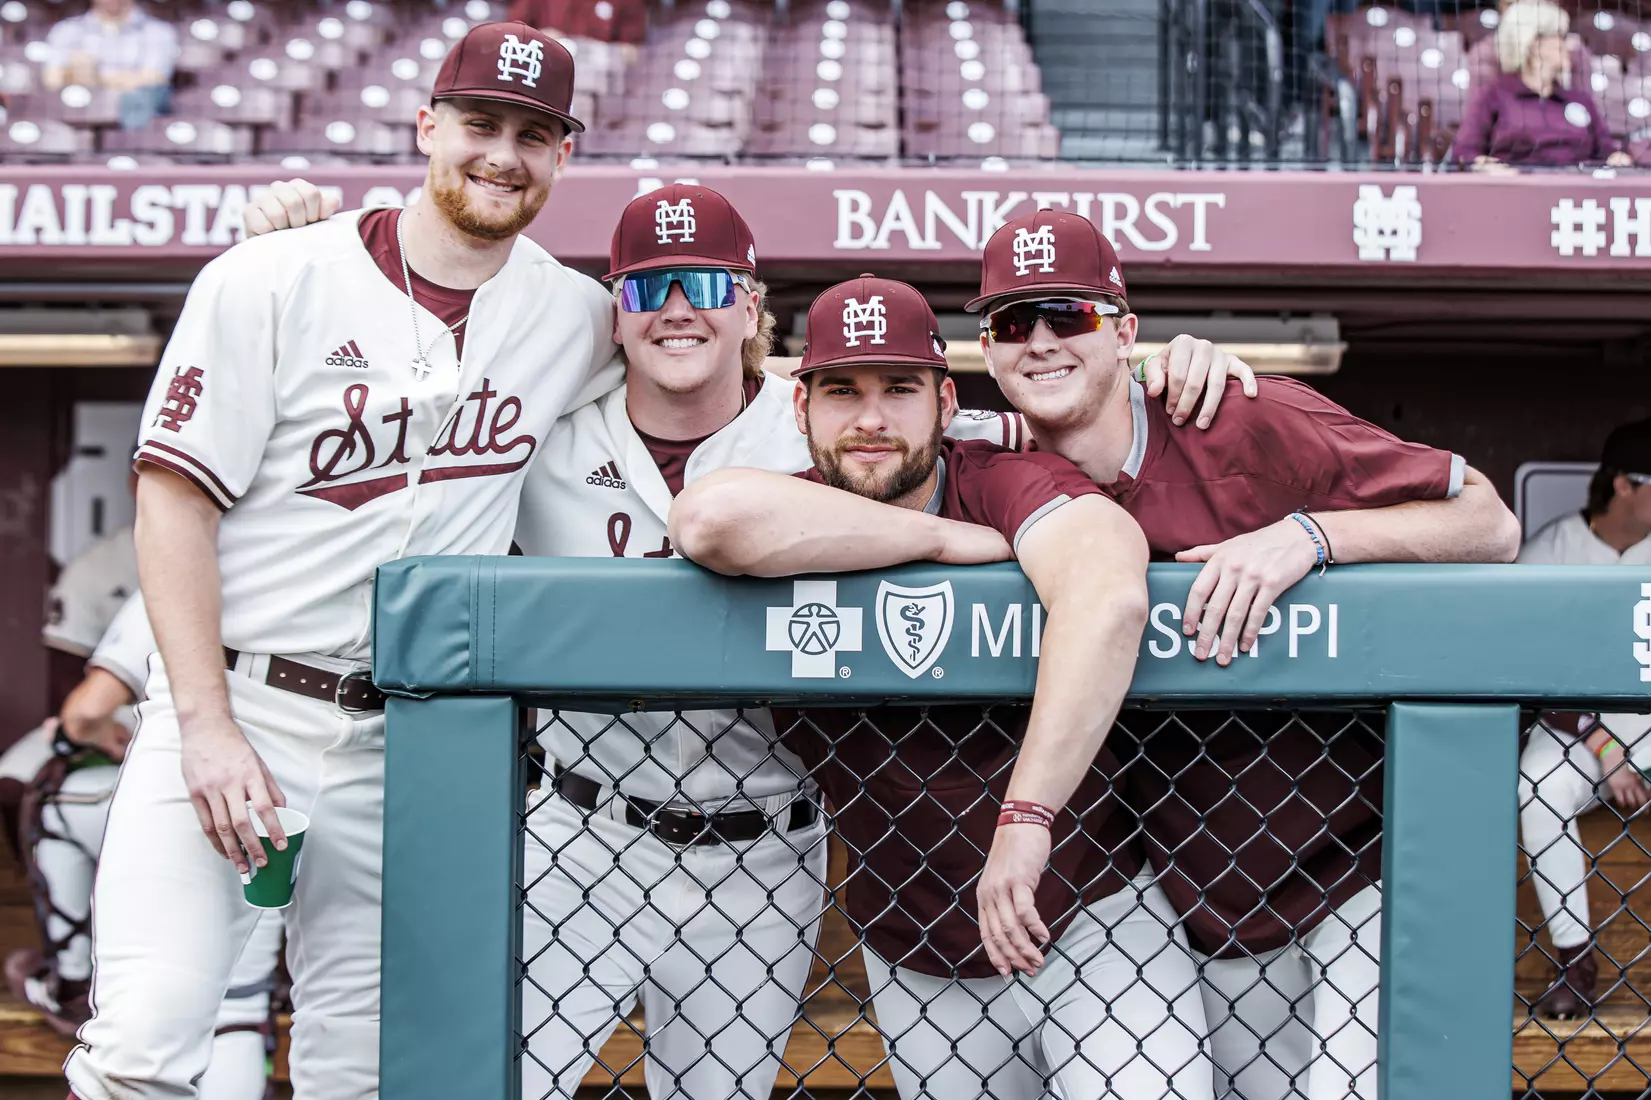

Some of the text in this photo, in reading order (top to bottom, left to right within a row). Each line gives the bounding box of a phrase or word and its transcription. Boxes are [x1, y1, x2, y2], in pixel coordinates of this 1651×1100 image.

[0, 183, 343, 246] AILSTA
[325, 355, 369, 369] adidas
[295, 377, 536, 491] State
[586, 473, 626, 490] adidas
[971, 602, 1338, 659] MISPPI
